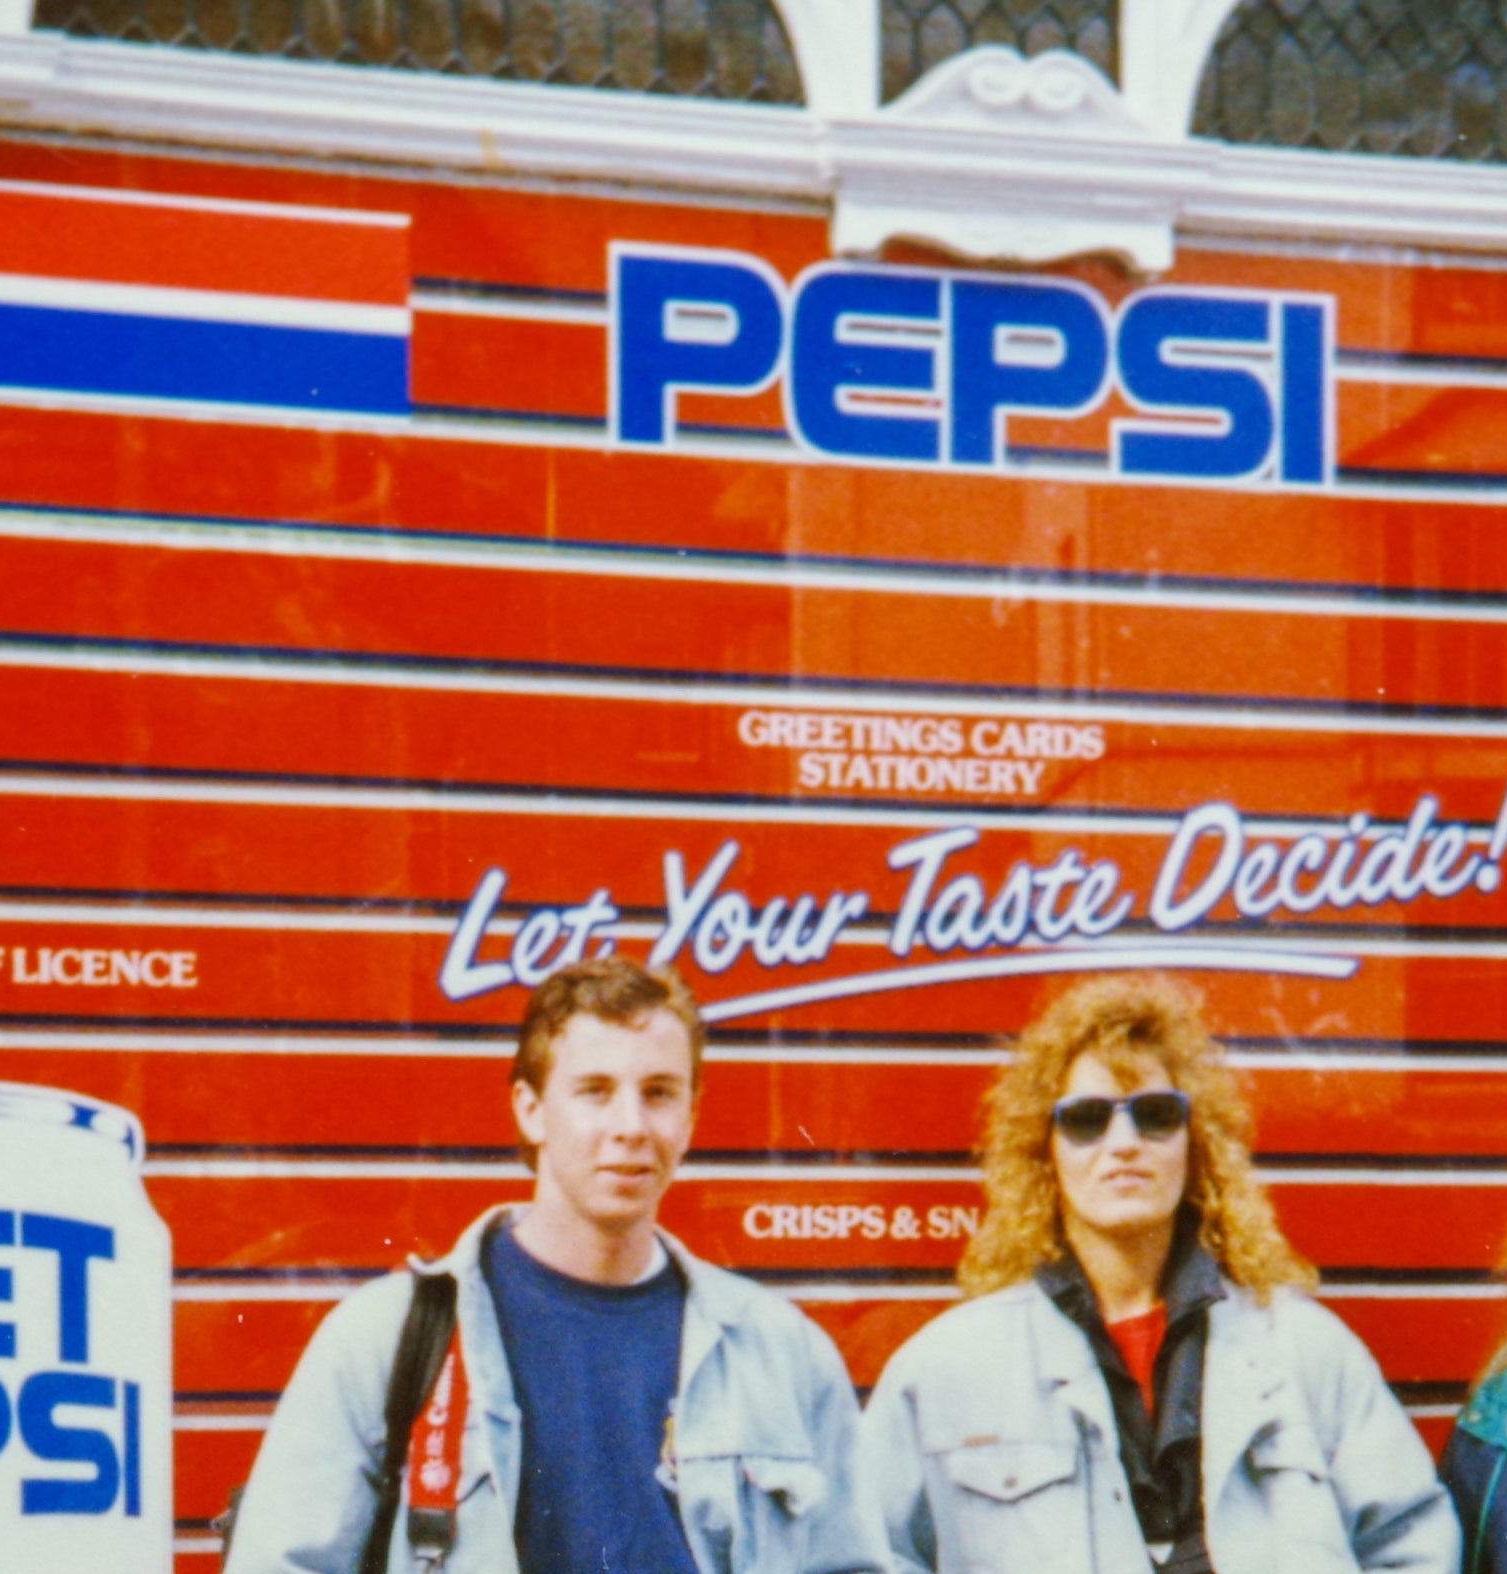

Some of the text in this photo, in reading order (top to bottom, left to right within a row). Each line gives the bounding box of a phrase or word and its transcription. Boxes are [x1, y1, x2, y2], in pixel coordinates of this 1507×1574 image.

[611, 243, 1335, 488] PEPSI
[738, 709, 1107, 760] GREETINGS CARDS
[798, 751, 1045, 795] STATIONERY
[439, 866, 620, 1000] Let
[646, 839, 870, 974] Your
[888, 826, 1134, 957] Taste
[11, 947, 198, 988] LICENCE
[743, 1202, 981, 1239] CRISPS & SN
